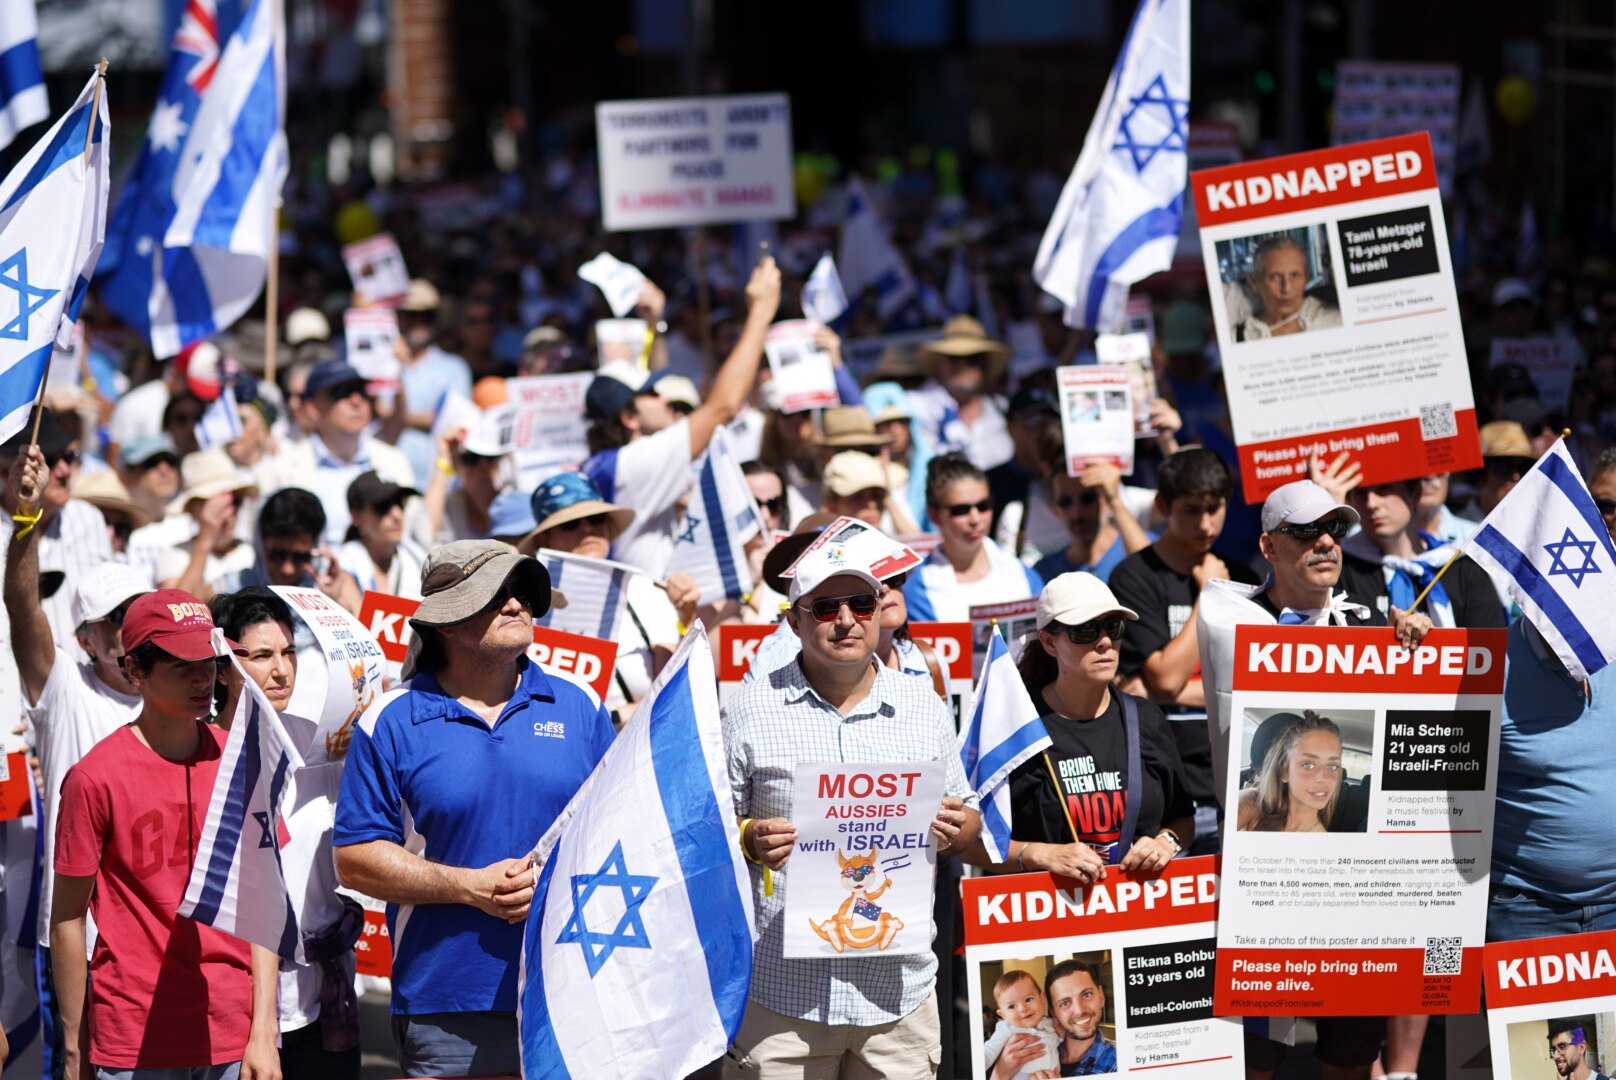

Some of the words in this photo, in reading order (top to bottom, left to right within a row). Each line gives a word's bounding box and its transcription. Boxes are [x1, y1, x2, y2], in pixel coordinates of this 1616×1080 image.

[1206, 150, 1422, 212] KIDNAPPED
[1345, 228, 1375, 244] Tami
[1377, 222, 1426, 239] Metzger
[1347, 235, 1423, 259] 78-years-old
[1349, 256, 1388, 274] Israeli
[1253, 446, 1296, 464] Please
[1329, 436, 1365, 452] bring
[1366, 432, 1399, 444] them
[1256, 462, 1292, 479] home
[1295, 458, 1329, 474] ale.
[329, 647, 346, 662] with
[344, 640, 381, 660] ISRAEL
[1249, 642, 1493, 676] KIDNAPPED
[534, 722, 565, 734] CHESS
[1391, 724, 1414, 736] Mia
[1418, 724, 1464, 736] Schem
[1389, 741, 1405, 754] 21
[1409, 743, 1446, 757] years
[1450, 742, 1471, 753] old
[1058, 755, 1096, 778] BRING
[1388, 758, 1479, 771] Israeli-French
[818, 772, 922, 799] MOST
[1062, 775, 1095, 794] THEM
[1388, 795, 1434, 805] Kidnapped
[1436, 795, 1455, 803] from
[825, 803, 907, 819] AUSSIES
[1394, 807, 1419, 815] music
[1422, 807, 1451, 815] festival
[1453, 807, 1464, 817] by
[838, 819, 887, 833] stand
[1386, 819, 1416, 827] Hamas
[131, 803, 202, 880] GA
[799, 839, 835, 852] with
[847, 832, 931, 851] ISRAEL
[1240, 856, 1251, 864] On
[1252, 856, 1281, 865] October
[1320, 857, 1336, 865] than
[1239, 866, 1255, 874] from
[1257, 866, 1277, 874] Israel
[1307, 867, 1327, 875] Gaza
[1239, 880, 1258, 888] More
[1405, 881, 1432, 890] ranging
[1441, 882, 1456, 890] age
[1457, 880, 1473, 888] from
[978, 872, 1222, 926] KIDNAPPED
[1294, 899, 1320, 908] brutally
[1323, 900, 1359, 908] separated
[1419, 900, 1428, 908] by
[1430, 899, 1456, 907] Hamas
[1235, 935, 1257, 945] Take
[1259, 937, 1266, 945] a
[1268, 935, 1296, 947] photo
[1298, 936, 1307, 945] of
[1310, 936, 1327, 945] this
[1329, 936, 1358, 947] poster
[1361, 936, 1379, 945] and
[1381, 936, 1408, 945] share
[1409, 935, 1415, 945] it
[1128, 955, 1171, 969] Elkana
[1174, 950, 1215, 964] Bohbu
[1232, 959, 1281, 973] Please
[1285, 959, 1316, 976] help
[1320, 960, 1358, 976] bring
[1362, 960, 1398, 973] them
[1129, 973, 1144, 985] 33
[1147, 971, 1182, 987] years
[1185, 966, 1206, 979] old
[1497, 949, 1616, 990] KIDNA
[1231, 978, 1272, 991] home
[1276, 978, 1314, 991] alive.
[1130, 996, 1214, 1016] Israeli-Colombi
[1231, 1000, 1324, 1009] #KidnappedFromIsrael
[1135, 1027, 1180, 1041] Kidnapped
[1183, 1025, 1202, 1034] from
[1135, 1043, 1160, 1052] music
[1162, 1038, 1191, 1049] festival
[1136, 1055, 1147, 1064] by
[1149, 1052, 1179, 1062] Hamas
